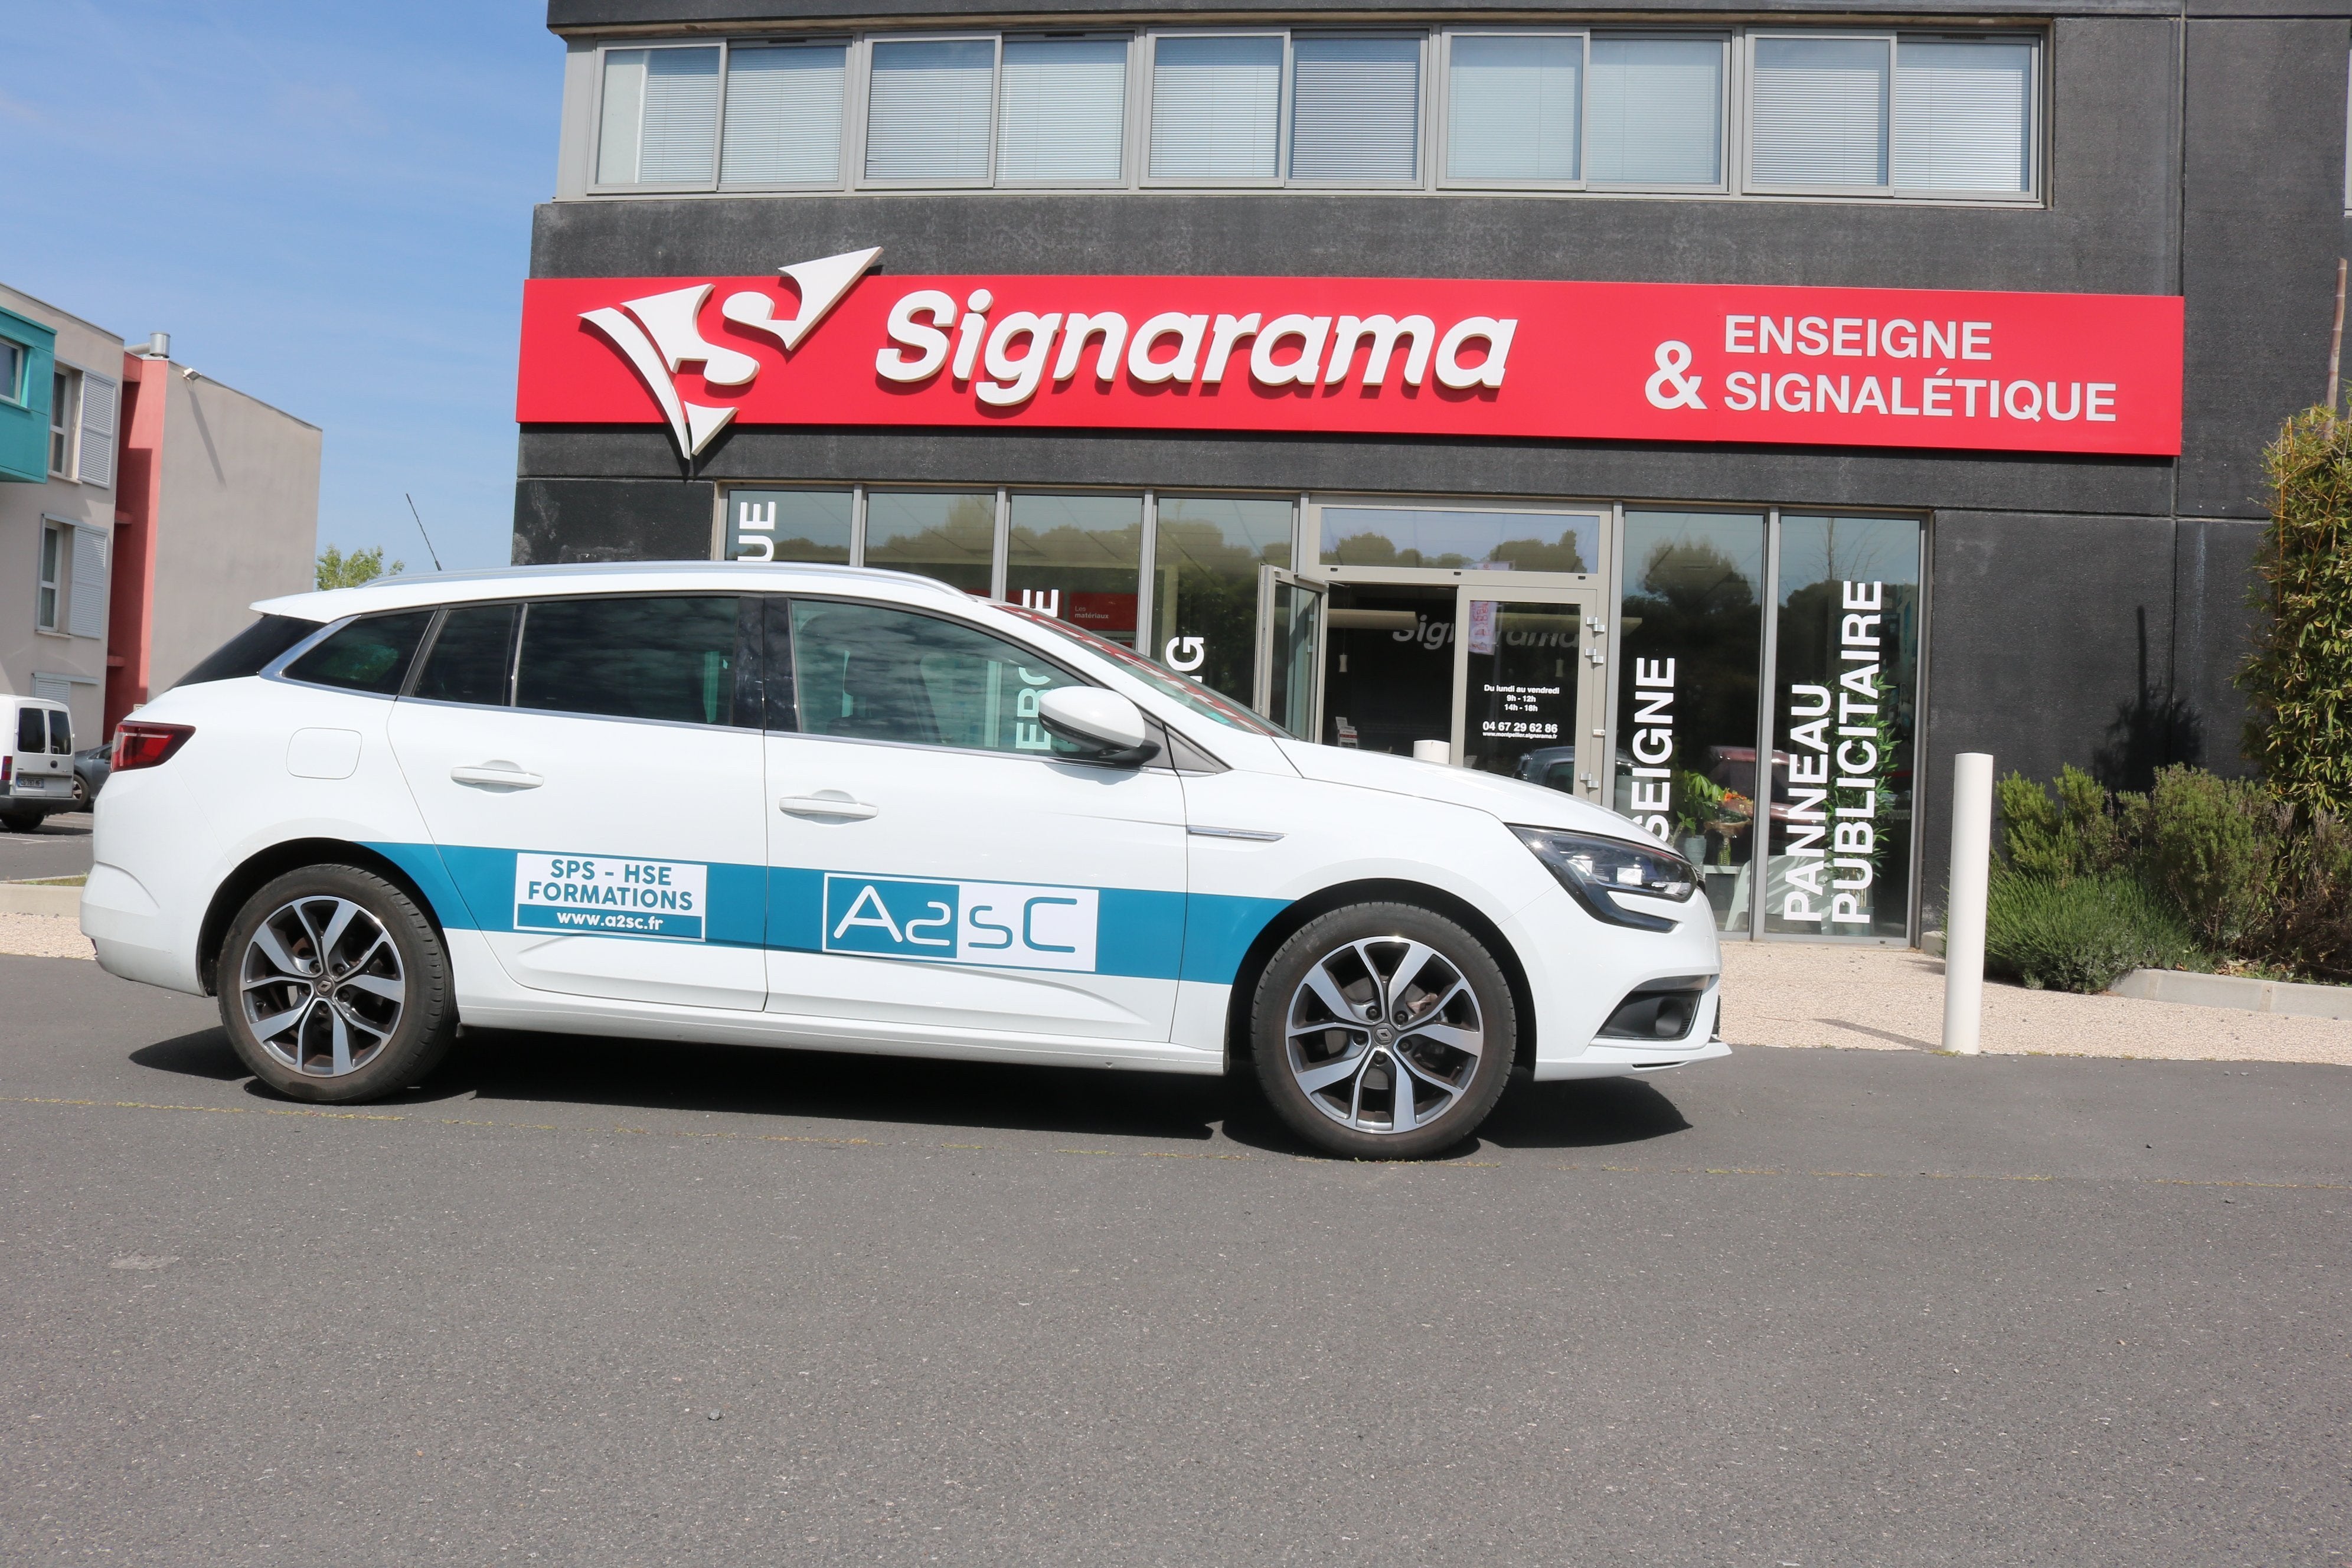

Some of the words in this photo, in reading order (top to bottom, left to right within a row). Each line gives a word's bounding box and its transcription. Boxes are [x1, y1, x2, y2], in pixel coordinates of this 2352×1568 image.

[876, 289, 1519, 406] Signarama
[1725, 314, 1992, 361] ENSEIGNE
[1644, 339, 1707, 410] &
[1724, 367, 2117, 422] SIGNALÉTIQUE
[1482, 721, 1495, 731] 04
[1498, 721, 1511, 731] 67
[1514, 722, 1527, 732] 29
[1529, 723, 1542, 733] 62
[1544, 723, 1558, 733] 86
[1832, 580, 1882, 923] PUBLICITAIRE
[1783, 683, 1831, 922] PANNEAU
[528, 880, 692, 911] FORMATIONS
[550, 859, 594, 880] SPS
[624, 863, 672, 886] HSE
[557, 912, 663, 930] www.a2sc.fr
